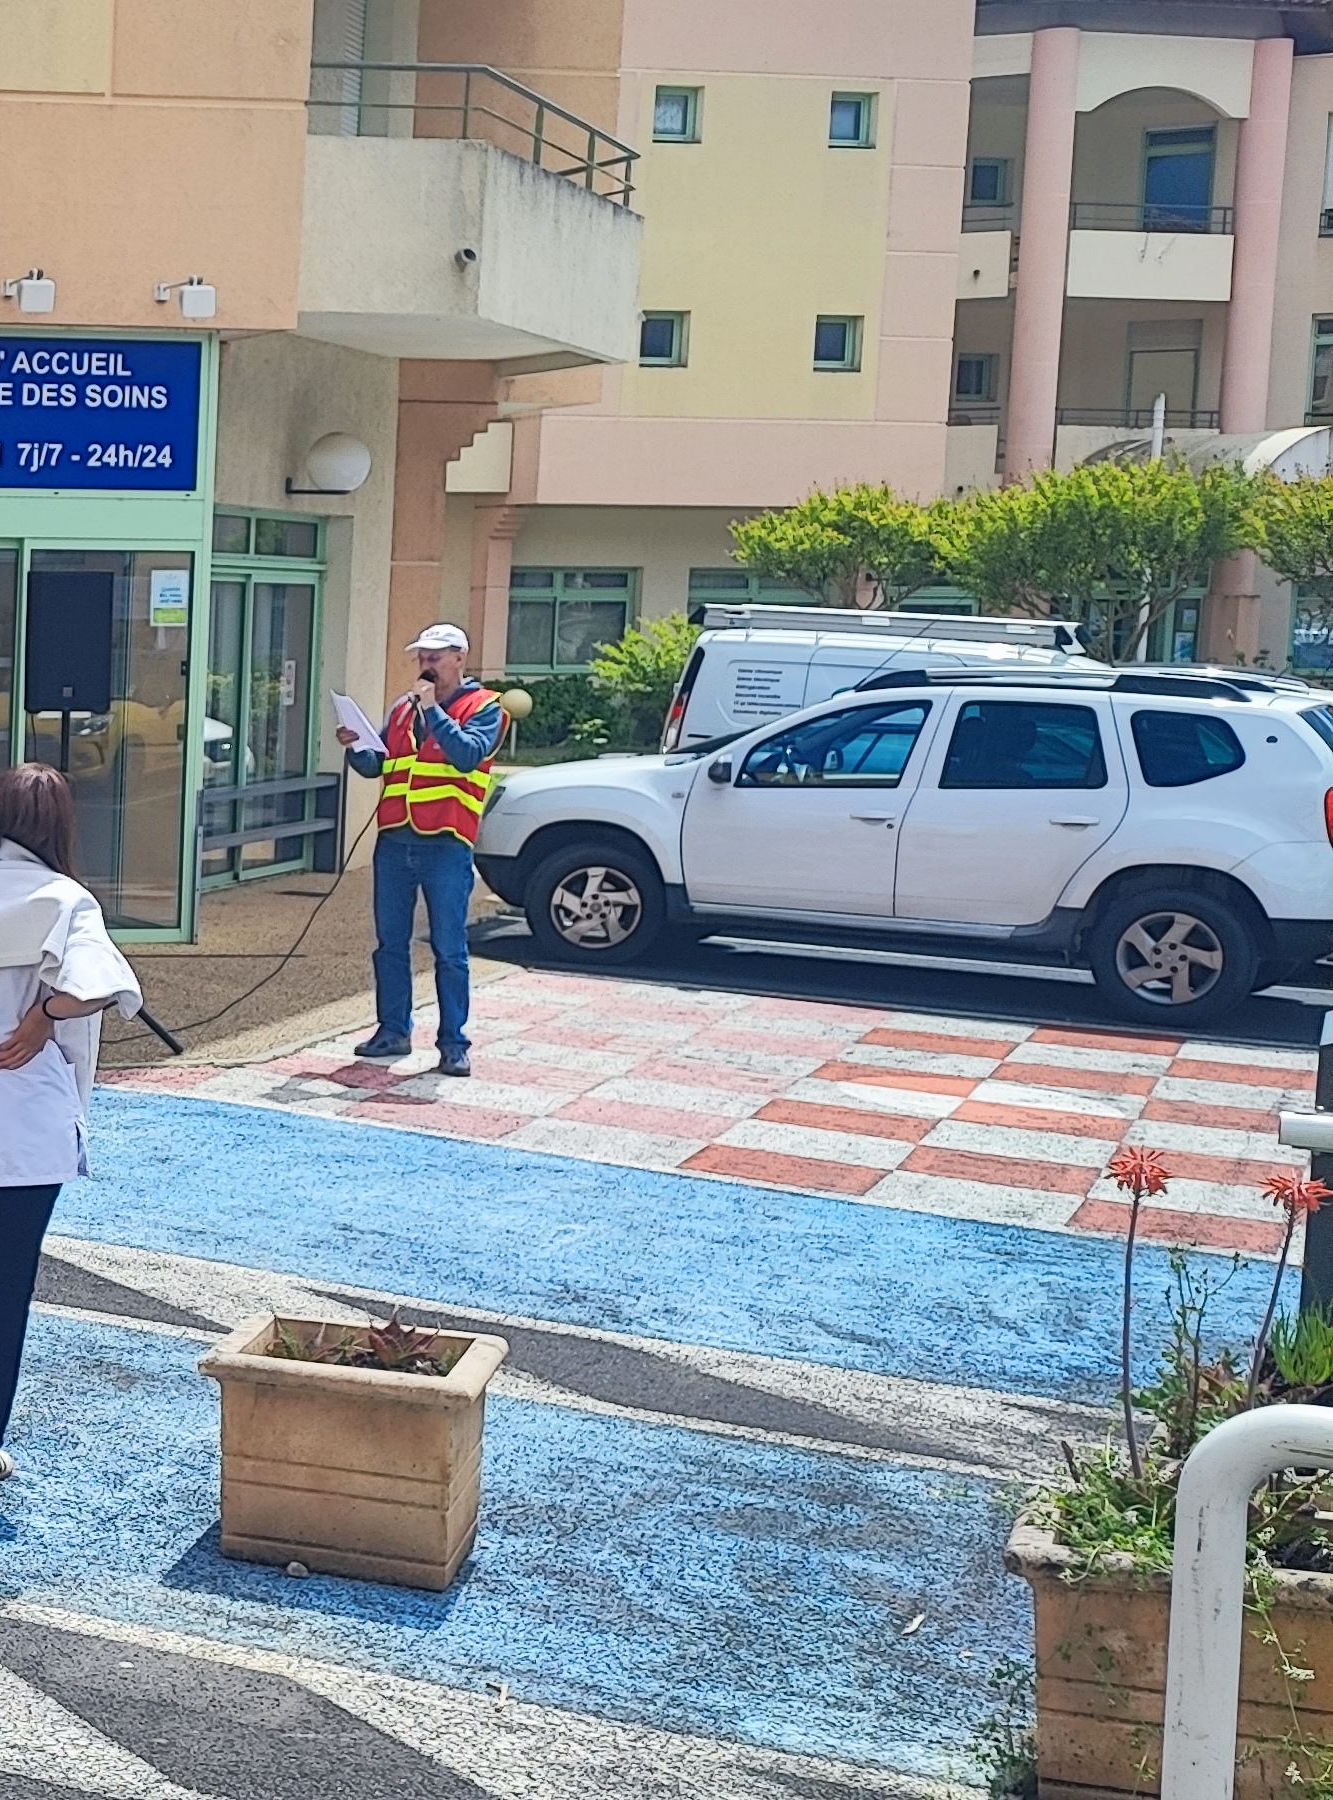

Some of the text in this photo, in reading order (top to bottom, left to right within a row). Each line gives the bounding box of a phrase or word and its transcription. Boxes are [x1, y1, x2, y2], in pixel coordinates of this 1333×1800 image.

[10, 350, 132, 377] ACCUEIL
[21, 382, 77, 407] DES
[84, 384, 168, 409] SOINS
[17, 443, 64, 472] 7j/7
[86, 443, 173, 468] 24h/24
